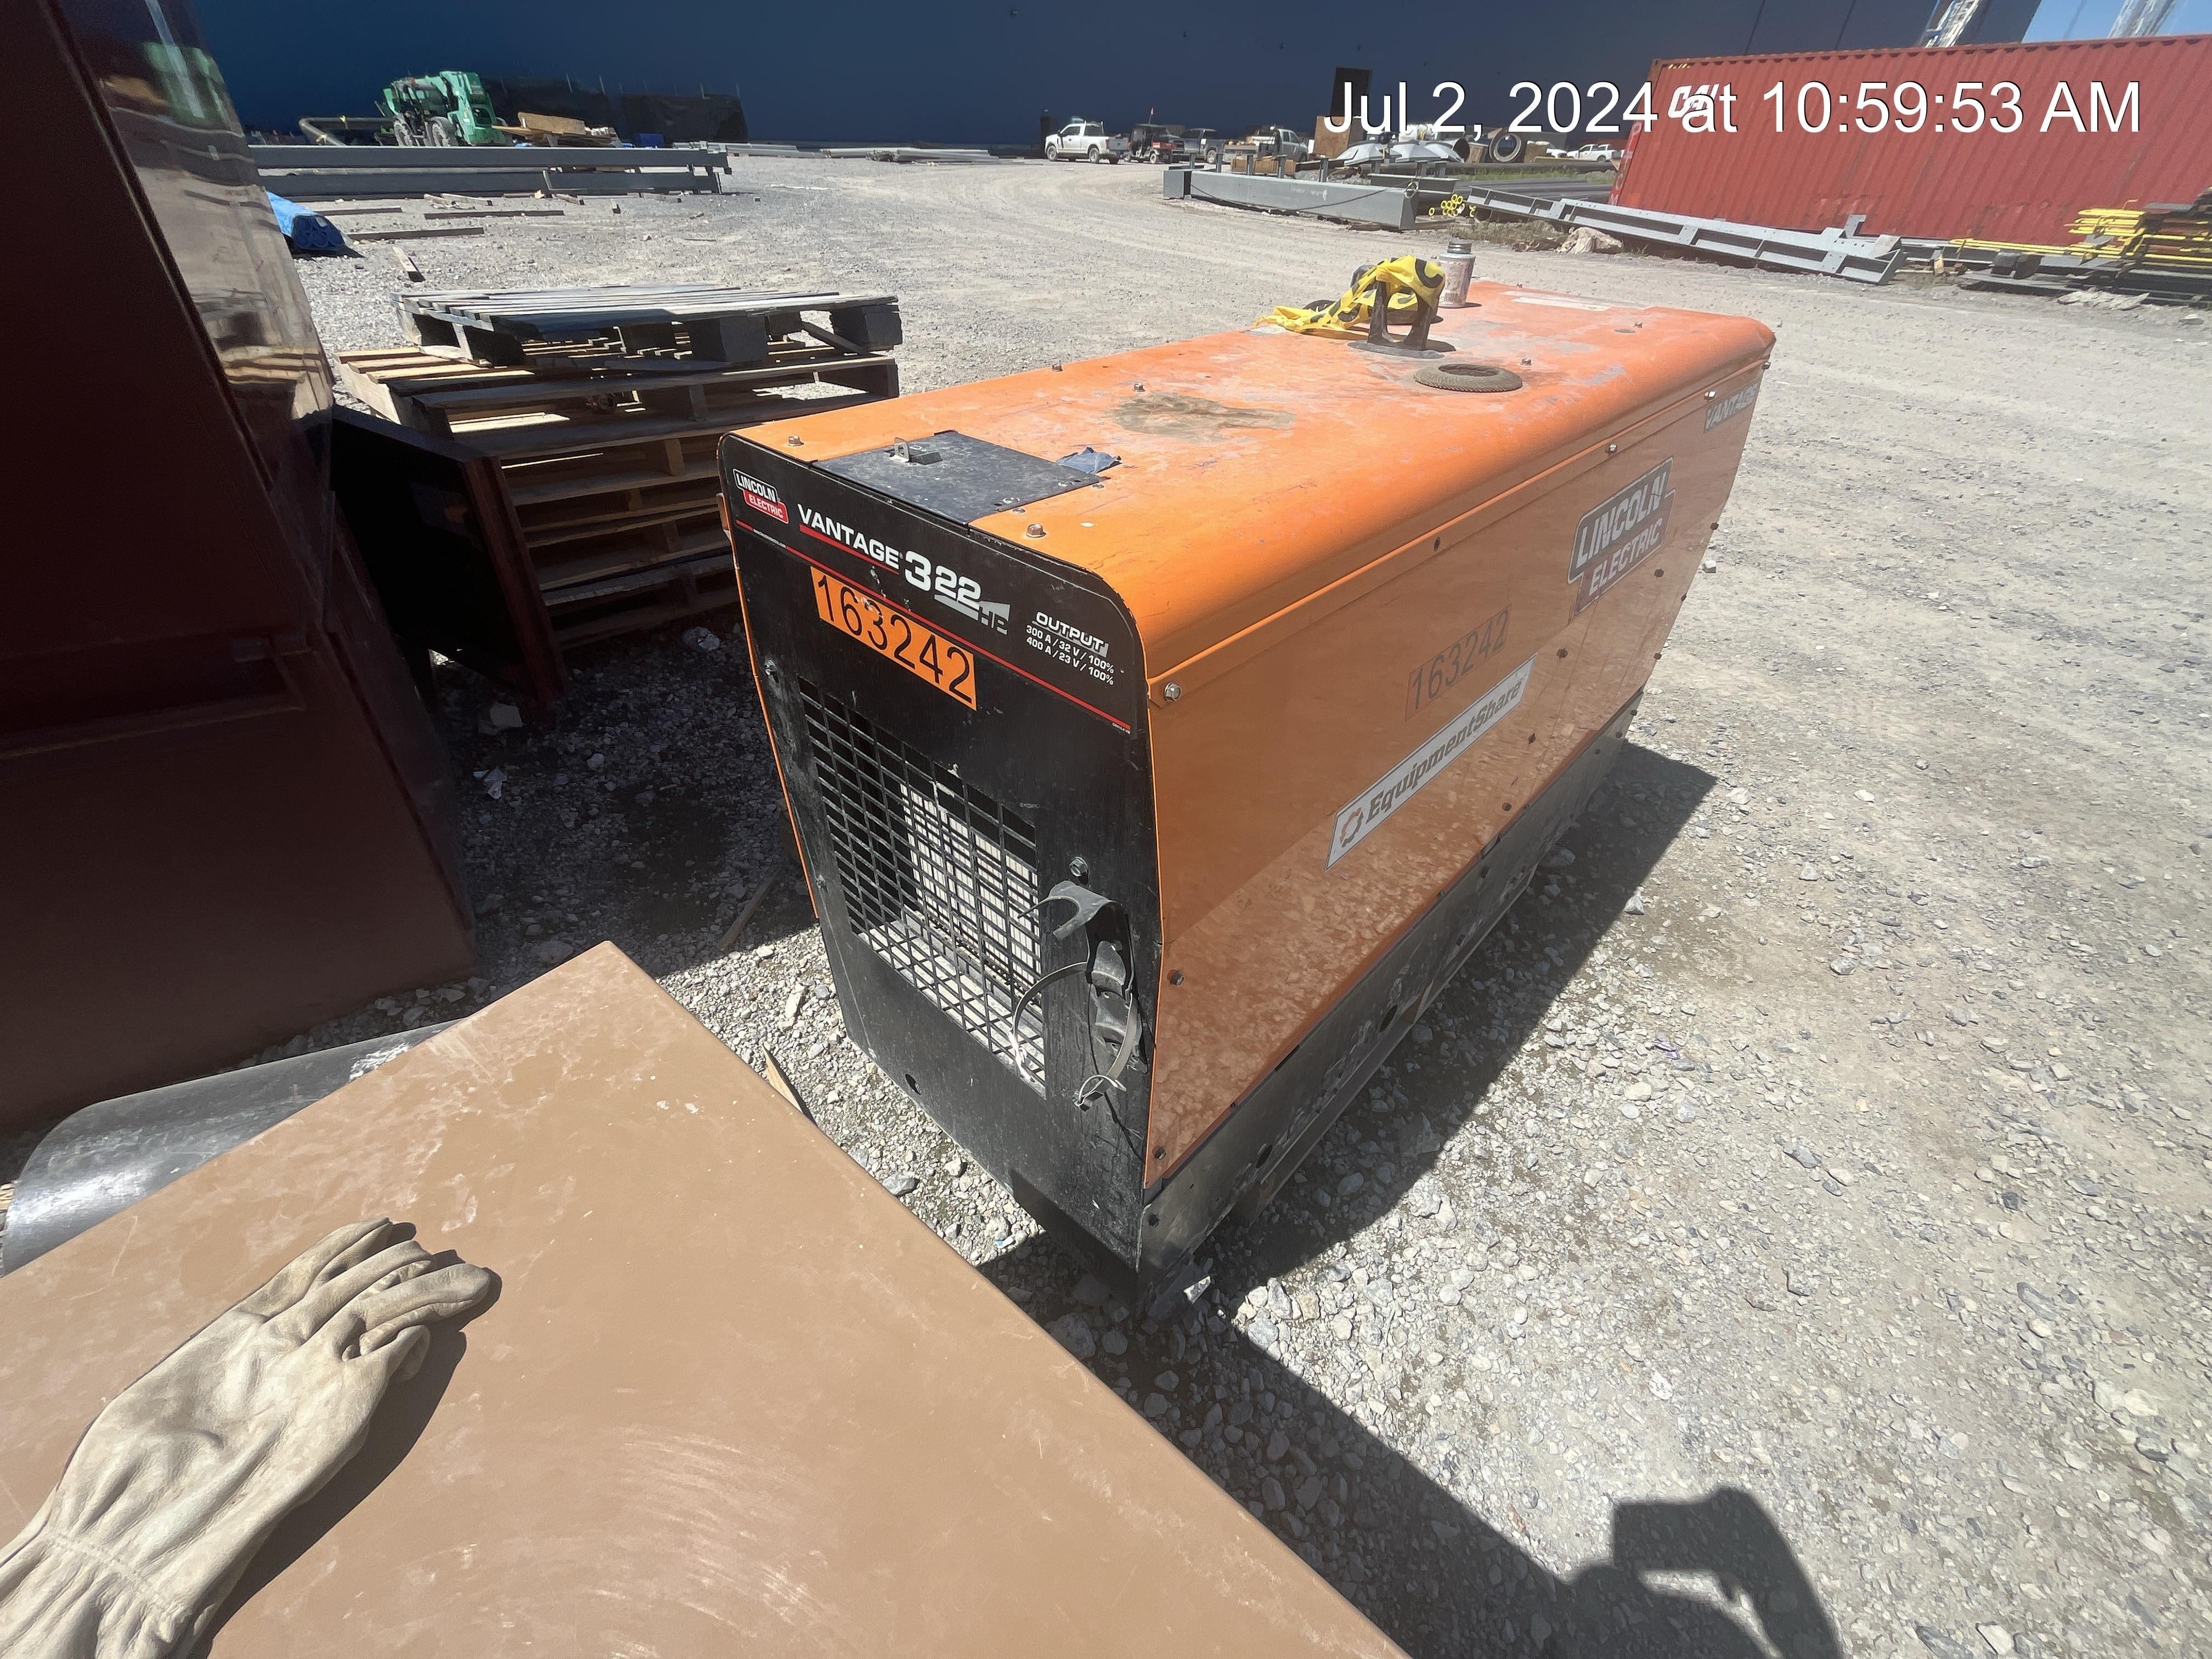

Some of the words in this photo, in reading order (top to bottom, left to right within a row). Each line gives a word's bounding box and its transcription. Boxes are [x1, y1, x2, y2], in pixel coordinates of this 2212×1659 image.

[736, 473, 776, 503] LINCOLN
[748, 494, 783, 518] ELECTRIC
[1575, 471, 1668, 568] LINCOLN
[797, 503, 900, 570] VANTAGE
[904, 550, 981, 610] 322
[1588, 516, 1664, 597] ELECTRIC
[818, 574, 973, 705] 163242
[1026, 625, 1043, 640] 300
[1045, 634, 1052, 644] A
[1059, 641, 1071, 653] 32
[1073, 646, 1080, 657] V
[1088, 654, 1114, 674] 100%
[1026, 636, 1043, 651] 400
[1045, 645, 1052, 656] A
[1059, 652, 1071, 664] 23
[1073, 658, 1080, 668] V
[1088, 665, 1114, 686] 100%
[1036, 612, 1104, 651] OUTPUT
[1412, 608, 1511, 712] 163242
[1365, 676, 1524, 825] EquipmentShare
